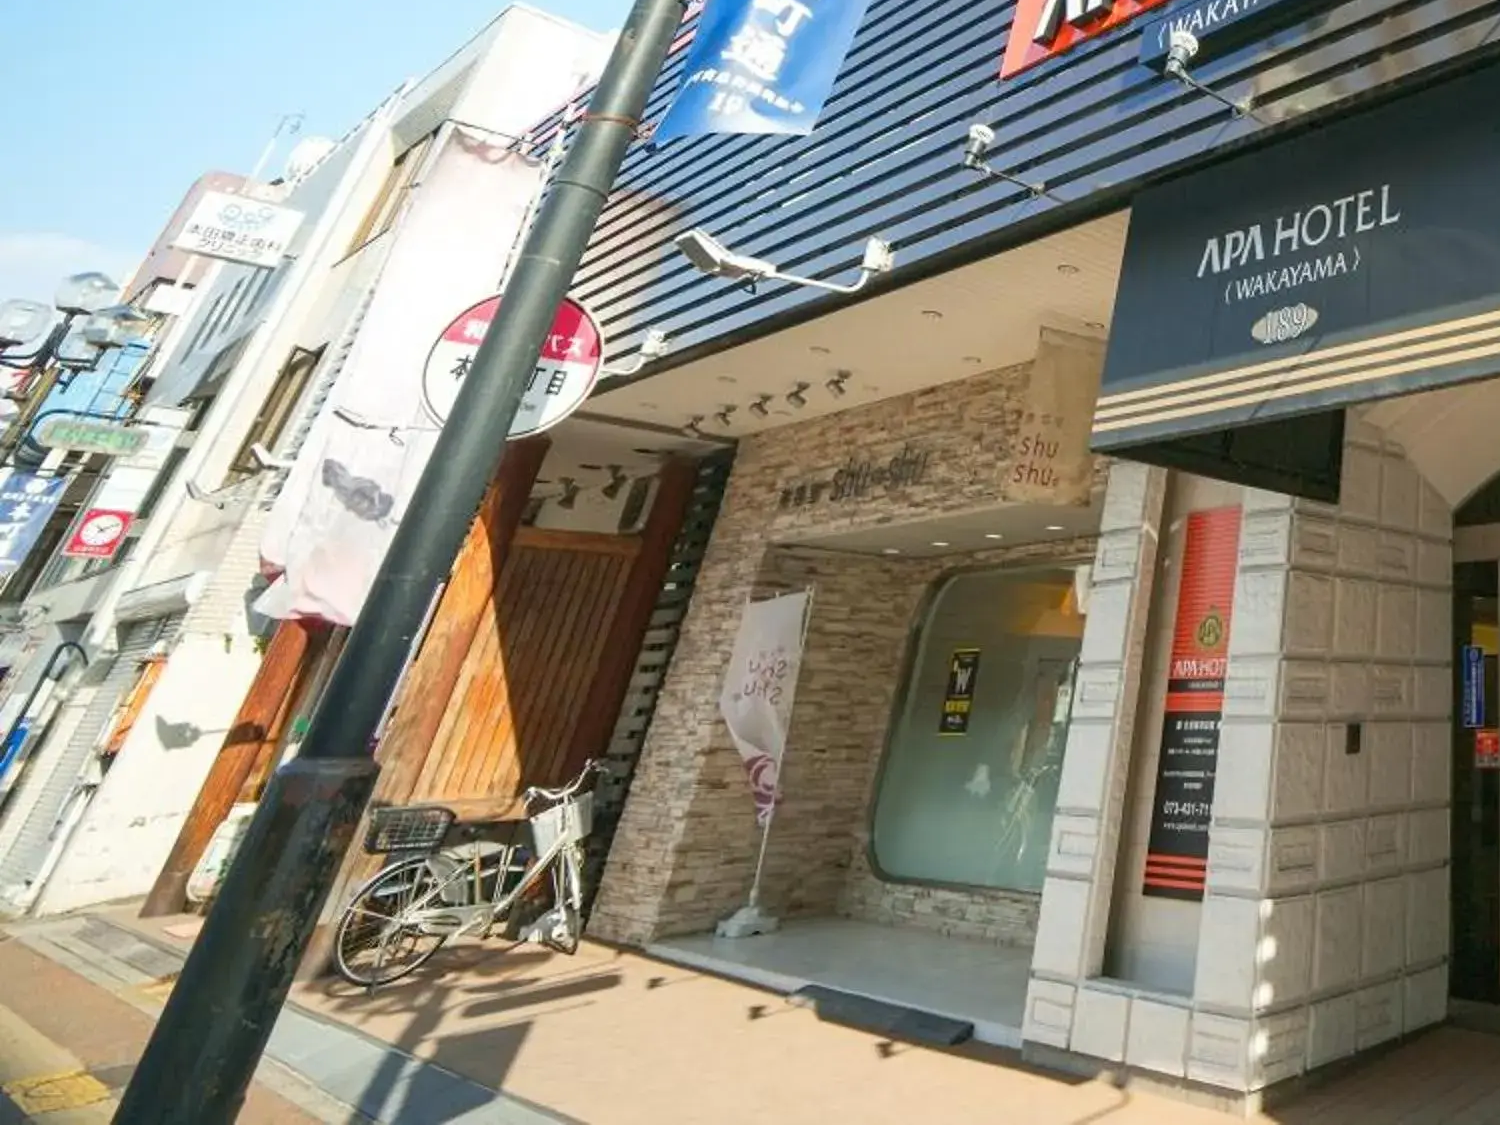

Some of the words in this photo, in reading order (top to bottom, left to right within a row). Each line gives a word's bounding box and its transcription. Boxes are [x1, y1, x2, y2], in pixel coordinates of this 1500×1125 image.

[1197, 224, 1265, 278] APA
[1273, 184, 1401, 256] HOTEL
[1262, 301, 1307, 344] 189
[450, 354, 568, 396] 本丁目
